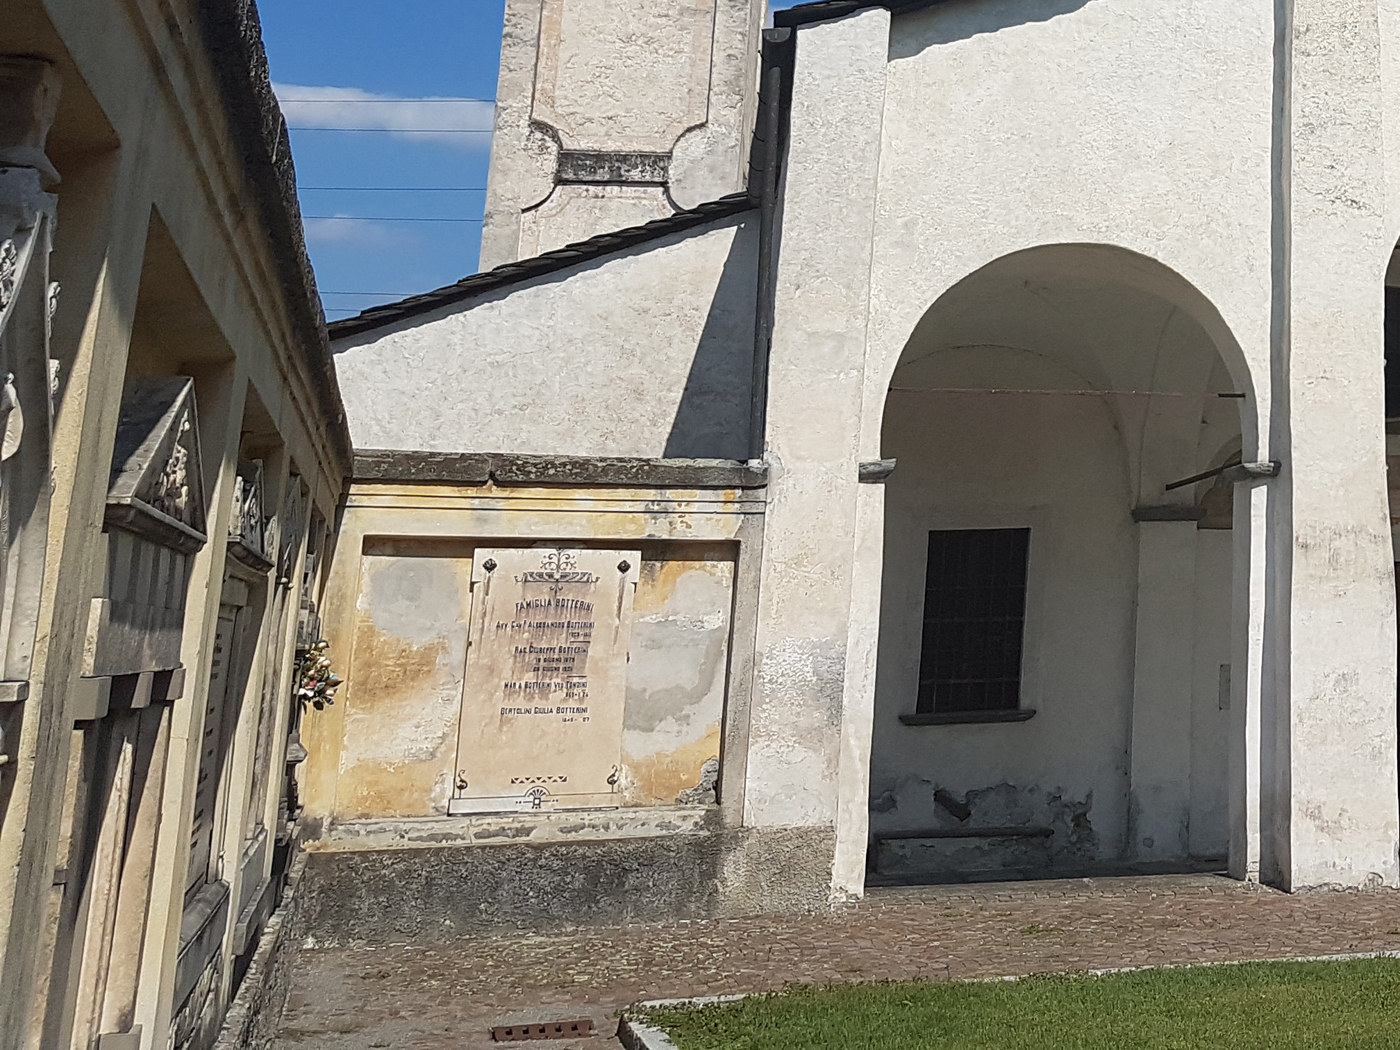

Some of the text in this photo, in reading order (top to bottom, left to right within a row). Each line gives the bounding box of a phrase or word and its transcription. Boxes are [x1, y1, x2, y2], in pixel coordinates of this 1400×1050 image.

[515, 598, 594, 611] FAMIGLIA BOTTERINI
[556, 706, 588, 714] BOTTERINI
